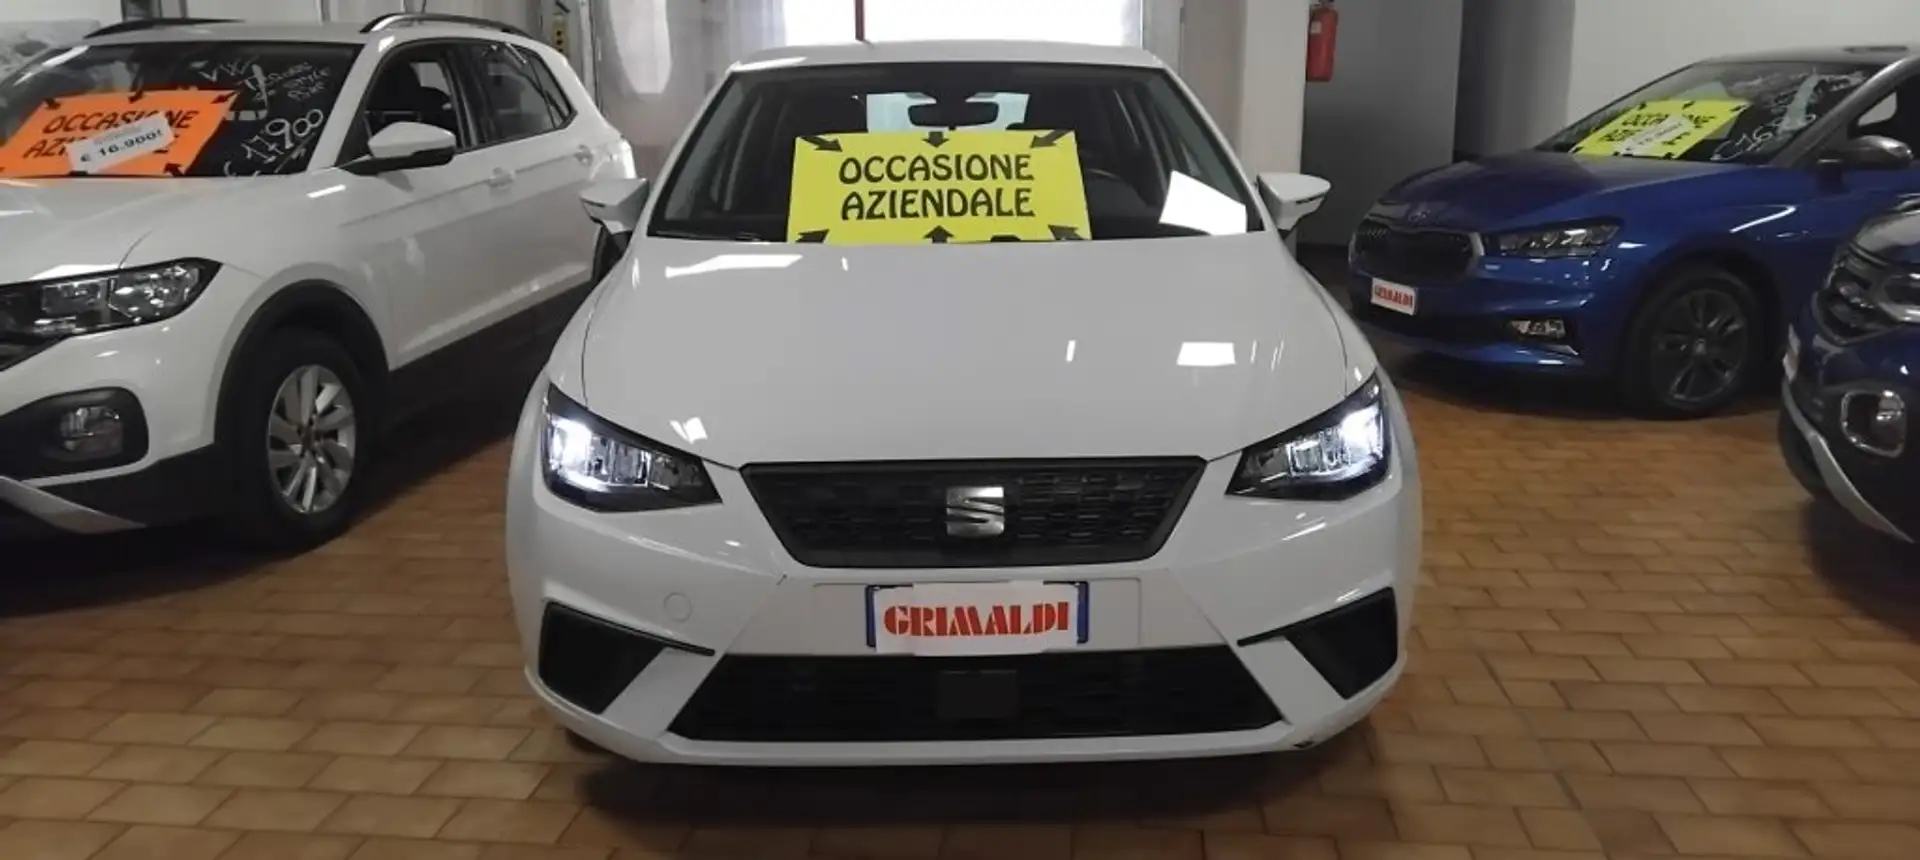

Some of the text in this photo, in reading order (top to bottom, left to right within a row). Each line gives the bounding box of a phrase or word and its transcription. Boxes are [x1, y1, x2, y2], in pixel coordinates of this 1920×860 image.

[838, 153, 1035, 185] OCCASIONE
[840, 187, 1036, 221] AZIENDALE
[883, 601, 1069, 637] GRIMALDI
